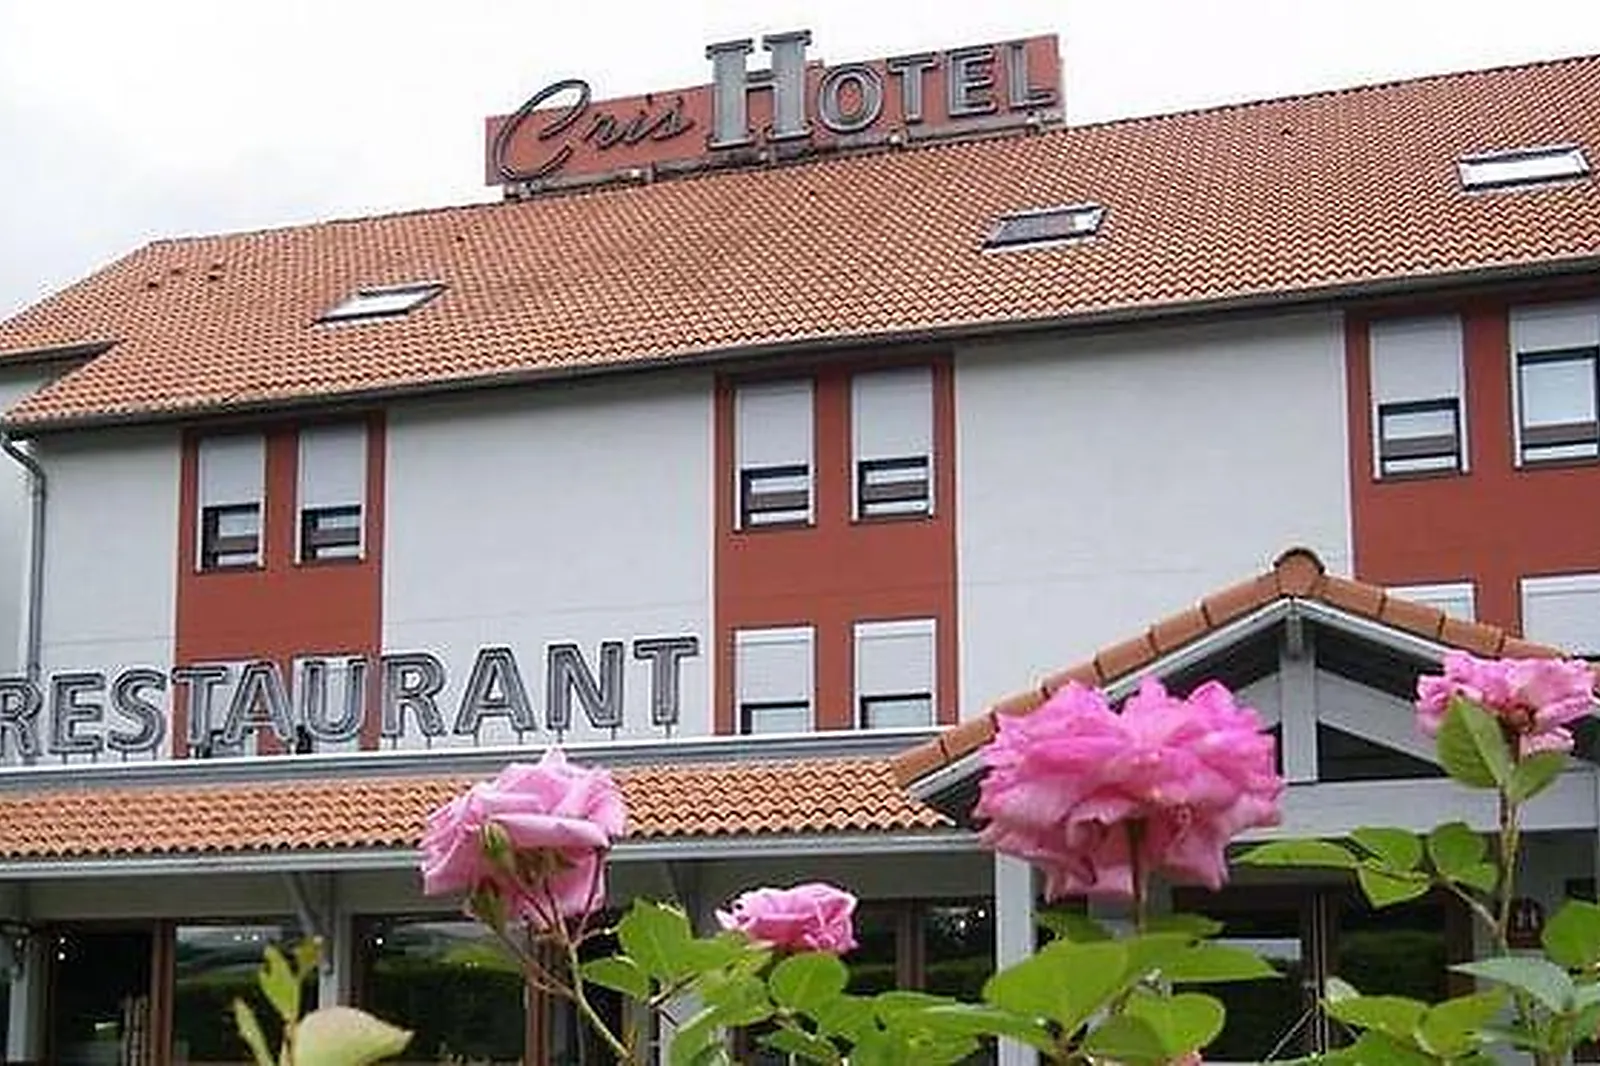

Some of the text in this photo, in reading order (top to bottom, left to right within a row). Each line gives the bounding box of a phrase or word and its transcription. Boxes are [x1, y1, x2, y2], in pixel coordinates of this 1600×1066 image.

[494, 29, 1056, 181] Cris HOTEL
[0, 637, 699, 756] RESTAURANT
